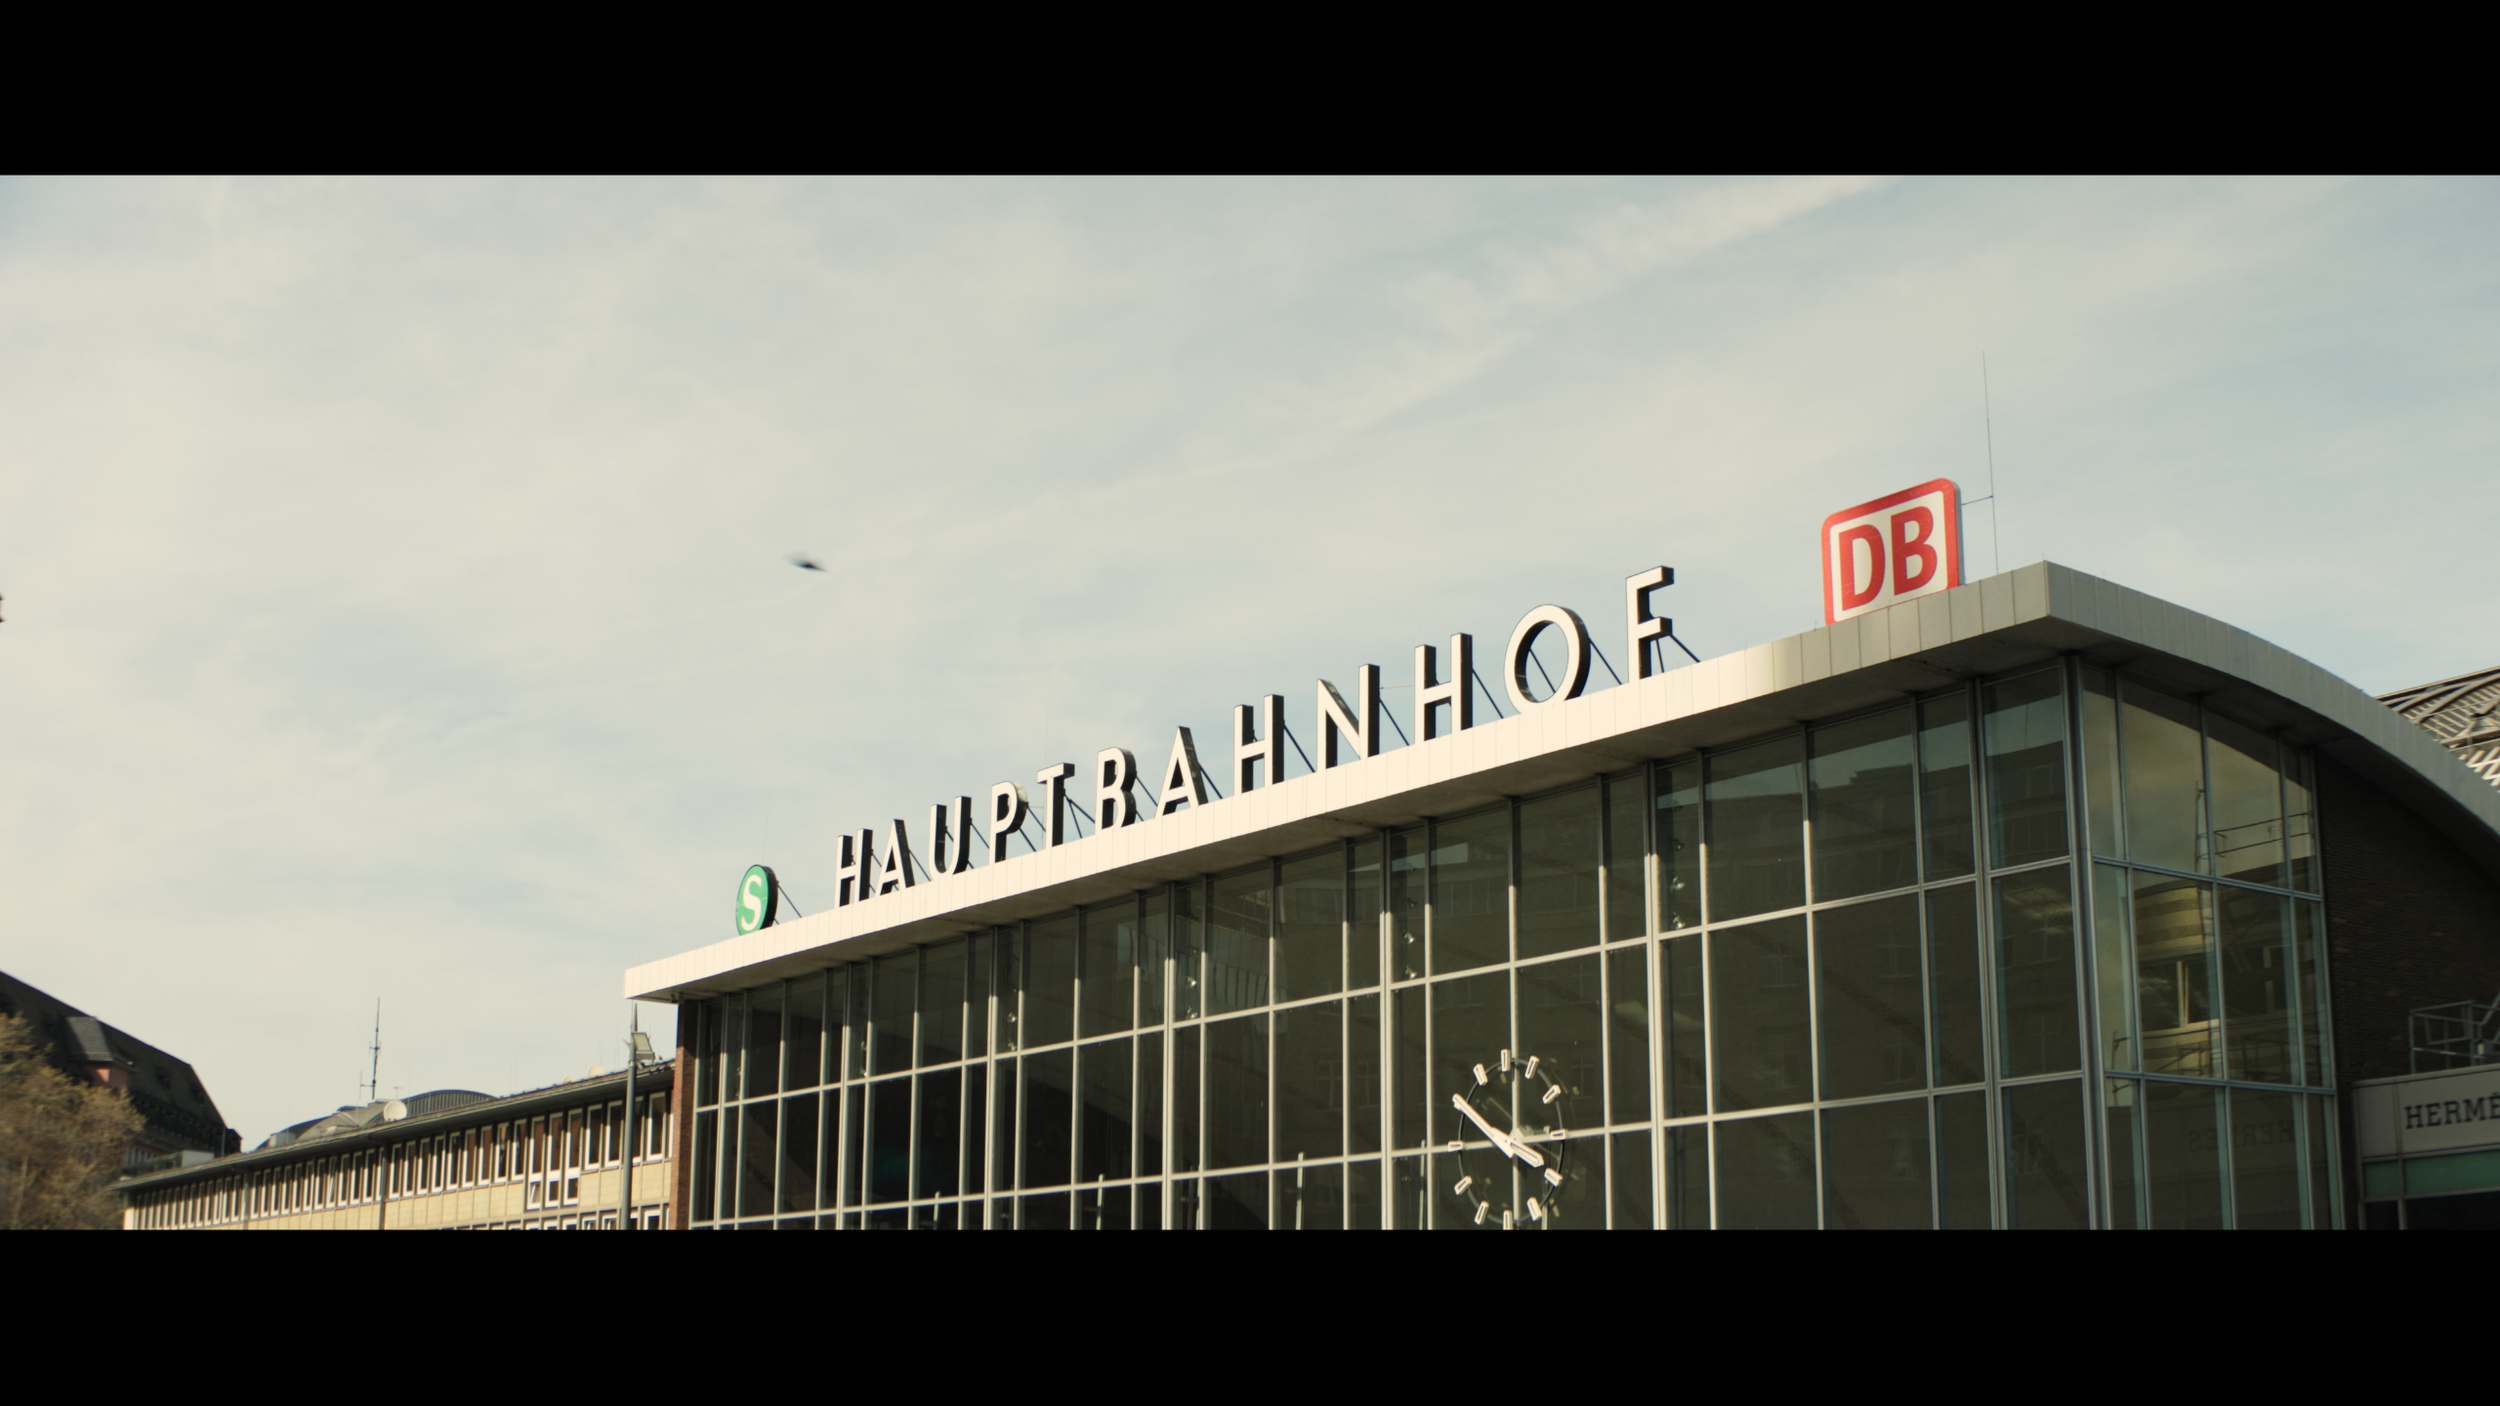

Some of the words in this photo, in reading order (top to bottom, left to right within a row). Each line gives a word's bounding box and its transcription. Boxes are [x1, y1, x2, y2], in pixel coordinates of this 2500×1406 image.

[1838, 506, 1938, 612] DB
[833, 565, 1674, 909] HAUPTBAHNHOF
[741, 874, 763, 931] S
